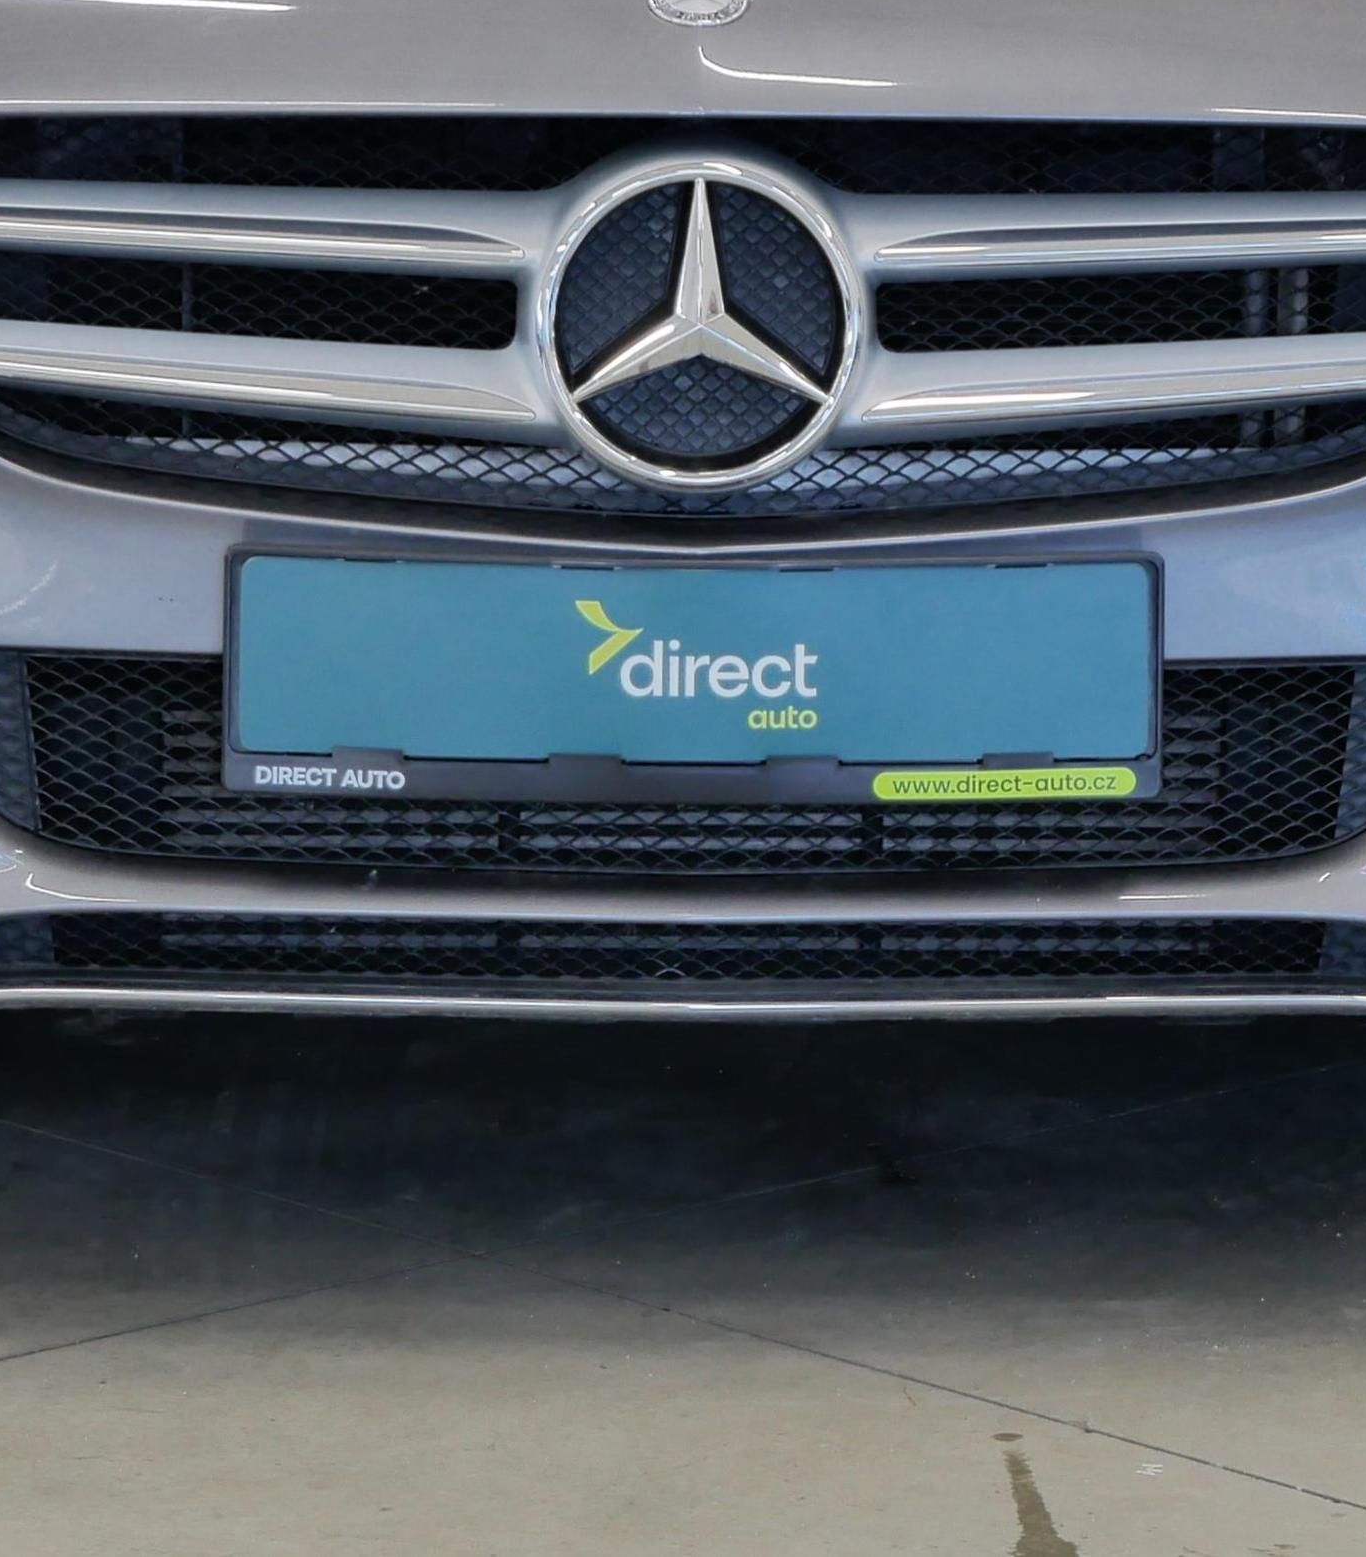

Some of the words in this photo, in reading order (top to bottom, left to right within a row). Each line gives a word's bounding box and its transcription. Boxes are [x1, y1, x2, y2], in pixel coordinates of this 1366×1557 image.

[620, 639, 818, 698] direct
[747, 705, 818, 729] auto
[255, 765, 337, 787] DIRECT
[341, 769, 406, 790] AUTO
[892, 774, 1116, 795] www.direct-auto.cz
